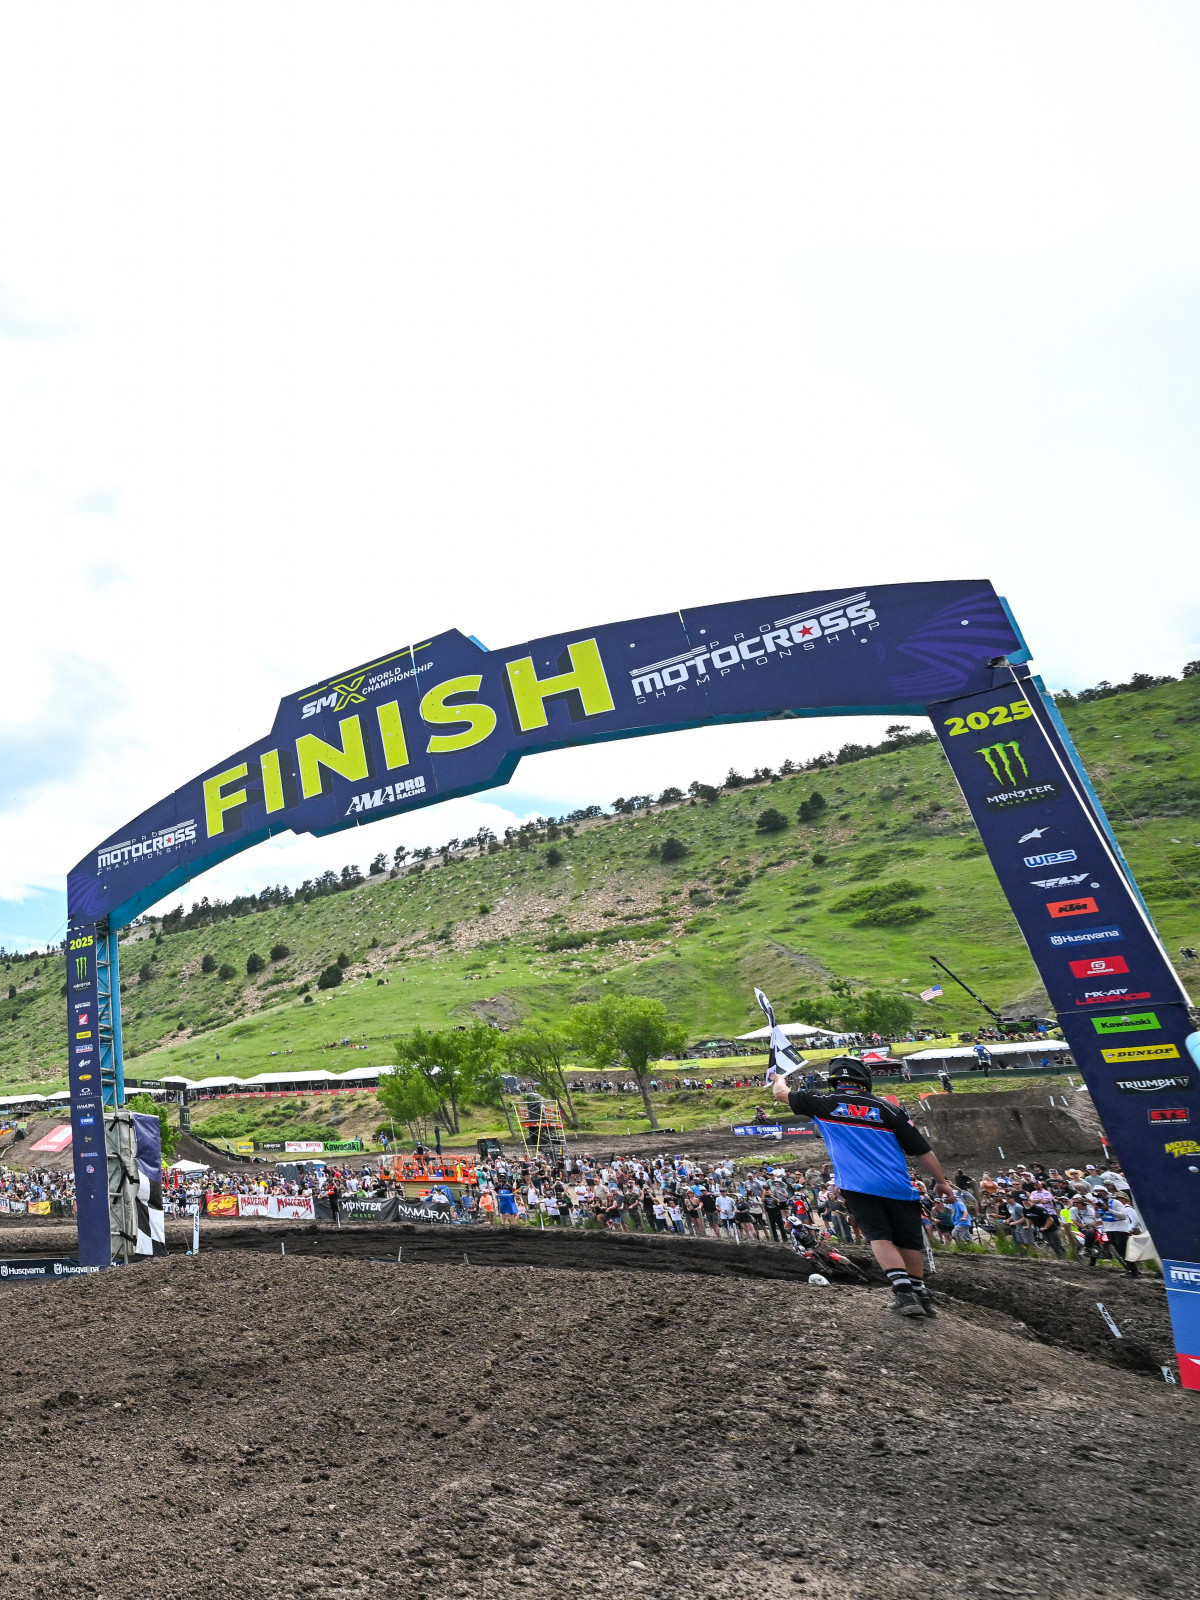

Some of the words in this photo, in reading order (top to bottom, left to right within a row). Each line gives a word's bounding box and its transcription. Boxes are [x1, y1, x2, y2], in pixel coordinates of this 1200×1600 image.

[710, 624, 771, 649] PRO
[631, 600, 877, 697] MOTOCROSS
[636, 621, 880, 704] CHAMPIONSHIP
[362, 662, 434, 695] CHAMPIONSHIP
[368, 667, 401, 685] WORLD
[301, 675, 367, 719] SMX
[943, 699, 1034, 737] 2025
[203, 638, 616, 838] FINISH
[395, 776, 425, 794] PRO
[397, 786, 427, 800] RACING
[344, 785, 395, 816] AMA
[987, 784, 1056, 804] MONSTER
[98, 823, 198, 868] MOTOCROSS
[98, 839, 197, 875] CHAMPIONSHIP
[1024, 850, 1077, 867] WPS
[1058, 902, 1088, 913] KTM
[70, 935, 93, 950] 2025
[1062, 929, 1120, 944] Husqvarna
[1101, 1018, 1152, 1028] Kawasaki
[1116, 1047, 1174, 1058] DUNLOP
[1116, 1078, 1176, 1090] TRIUMPH
[830, 1102, 883, 1124] AMA
[1151, 1109, 1187, 1120] ETS
[323, 1141, 359, 1152] Kawasaki
[1165, 1141, 1197, 1153] MOTO
[208, 1196, 238, 1211] FMF
[241, 1196, 269, 1211] MAVERIK
[277, 1197, 313, 1214] MAVERIK
[342, 1201, 382, 1211] MONSTER
[399, 1204, 449, 1220] NAMURA
[9, 1266, 46, 1275] Husqvarna
